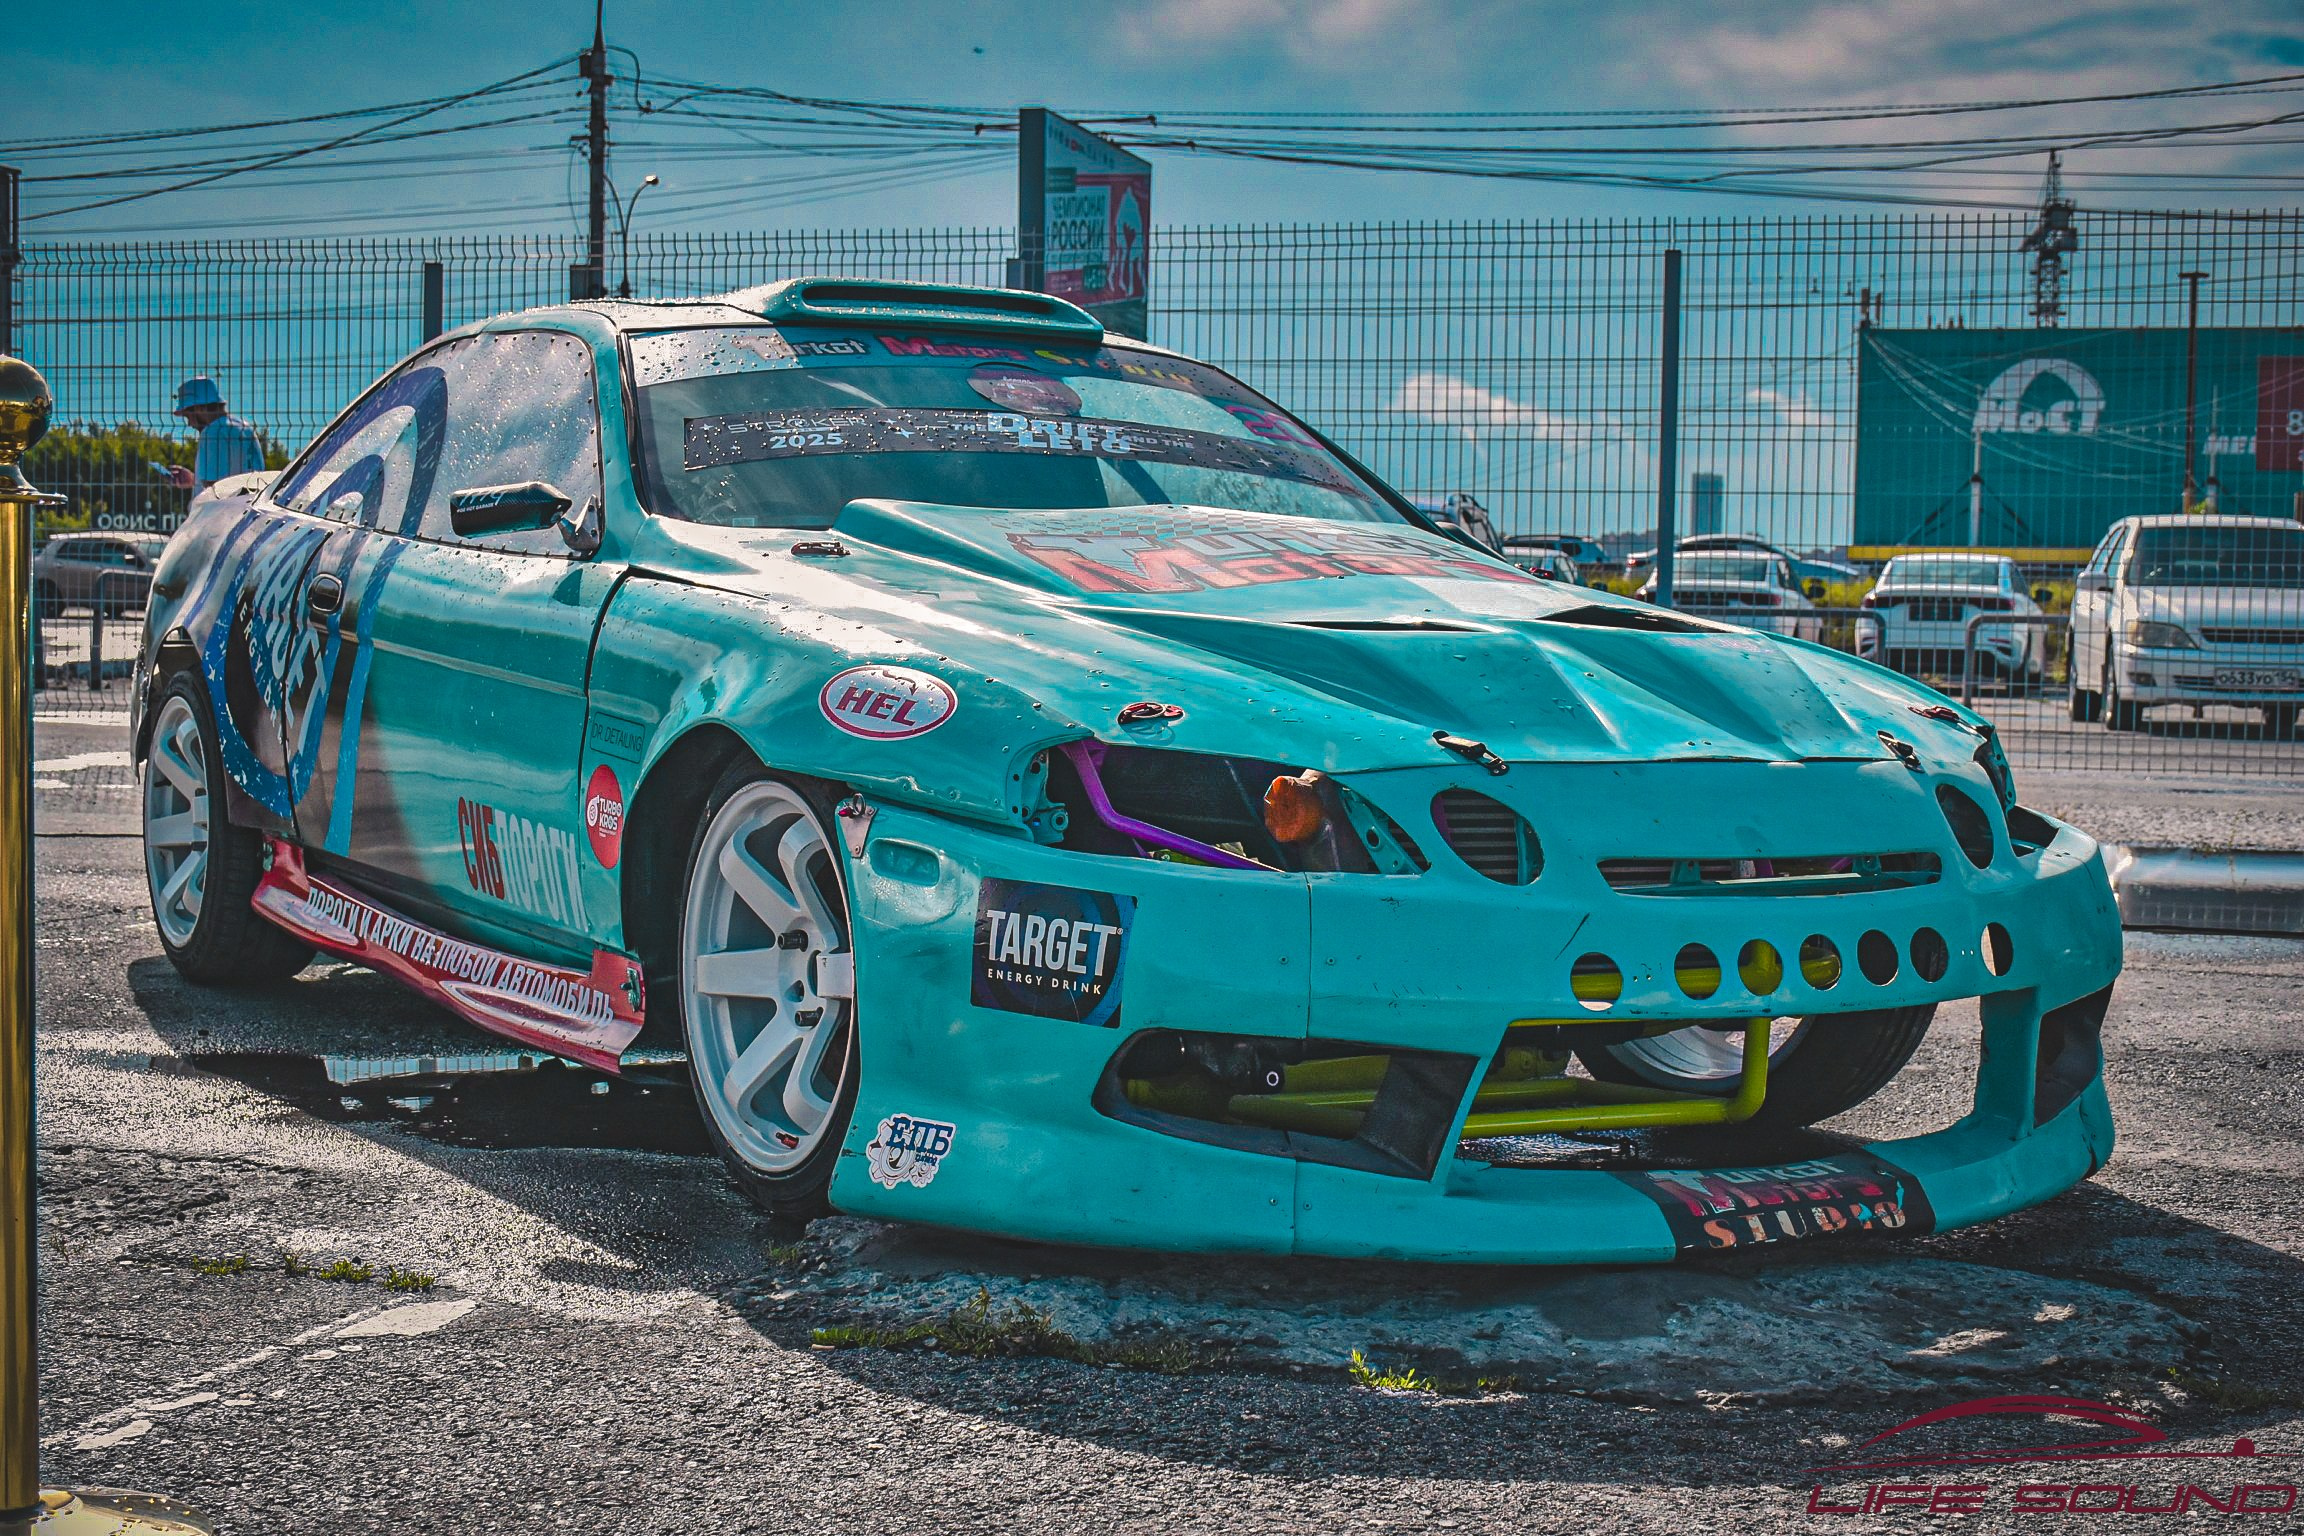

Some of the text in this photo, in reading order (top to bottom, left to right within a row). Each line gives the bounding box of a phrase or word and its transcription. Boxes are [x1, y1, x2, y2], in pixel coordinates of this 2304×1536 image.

[1050, 219, 1106, 250] РОССИИ
[770, 432, 843, 449] 2025
[987, 412, 1124, 438] DRIFT
[1162, 439, 1194, 449] THE
[1018, 431, 1132, 454] LETO
[1224, 405, 1325, 450] 20
[97, 512, 156, 530] ОФИС
[835, 686, 918, 726] HEL
[604, 726, 642, 752] DETAILING
[599, 813, 618, 831] KROS
[600, 798, 622, 816] TURBO
[302, 886, 360, 935] ПОРОГИ
[359, 908, 372, 938] И
[370, 913, 412, 956] АРКИ
[410, 931, 436, 965] НА
[496, 961, 615, 1027] АВТОМОБИЛЬ
[986, 909, 1118, 977] TARGET
[987, 968, 1102, 995] ENERGY DRINK
[886, 1117, 954, 1156] ЕПБ
[1703, 1202, 1906, 1249] STUDIO
